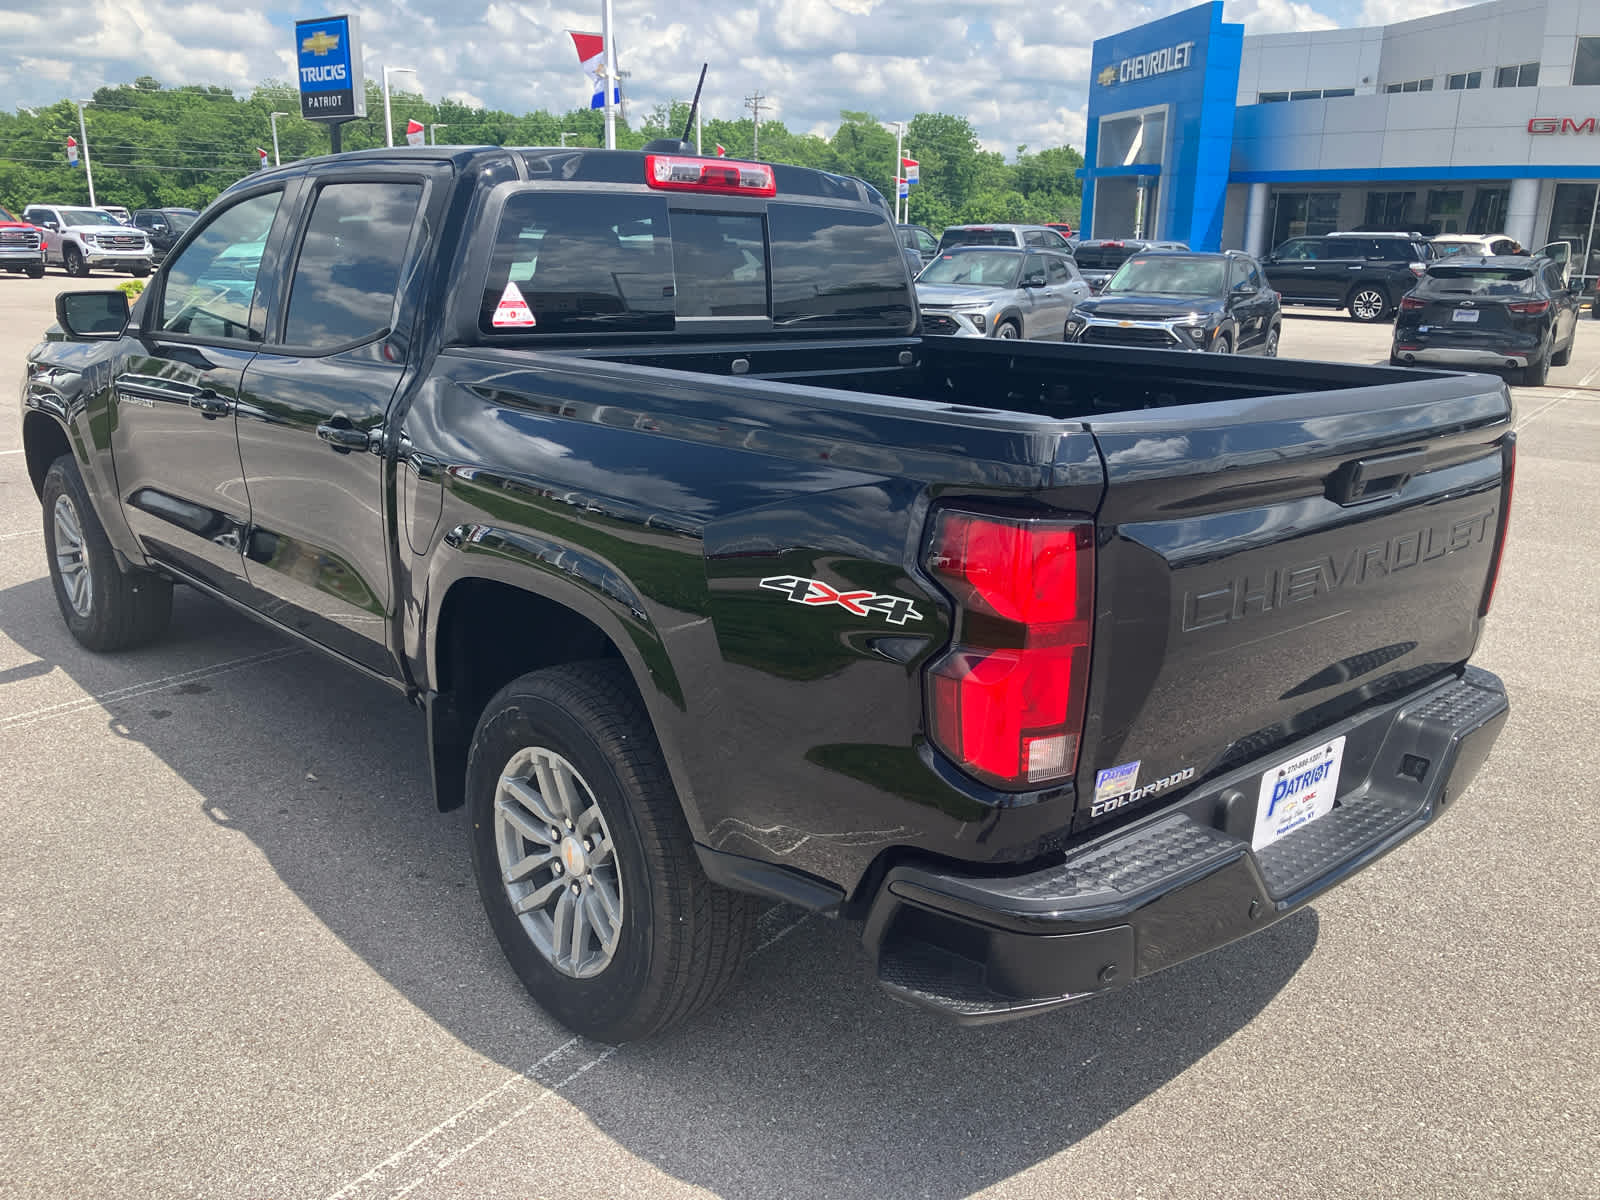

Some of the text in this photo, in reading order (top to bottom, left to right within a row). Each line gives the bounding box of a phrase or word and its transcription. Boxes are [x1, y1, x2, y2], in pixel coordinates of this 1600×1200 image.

[300, 64, 346, 82] TRUCKS
[1119, 41, 1195, 82] CHEVROLET
[308, 95, 342, 108] PATRIOT
[1527, 118, 1600, 133] GM
[1182, 506, 1495, 632] CHEVROLET
[1091, 767, 1195, 818] COLORADO
[1267, 760, 1334, 818] PATRIOT
